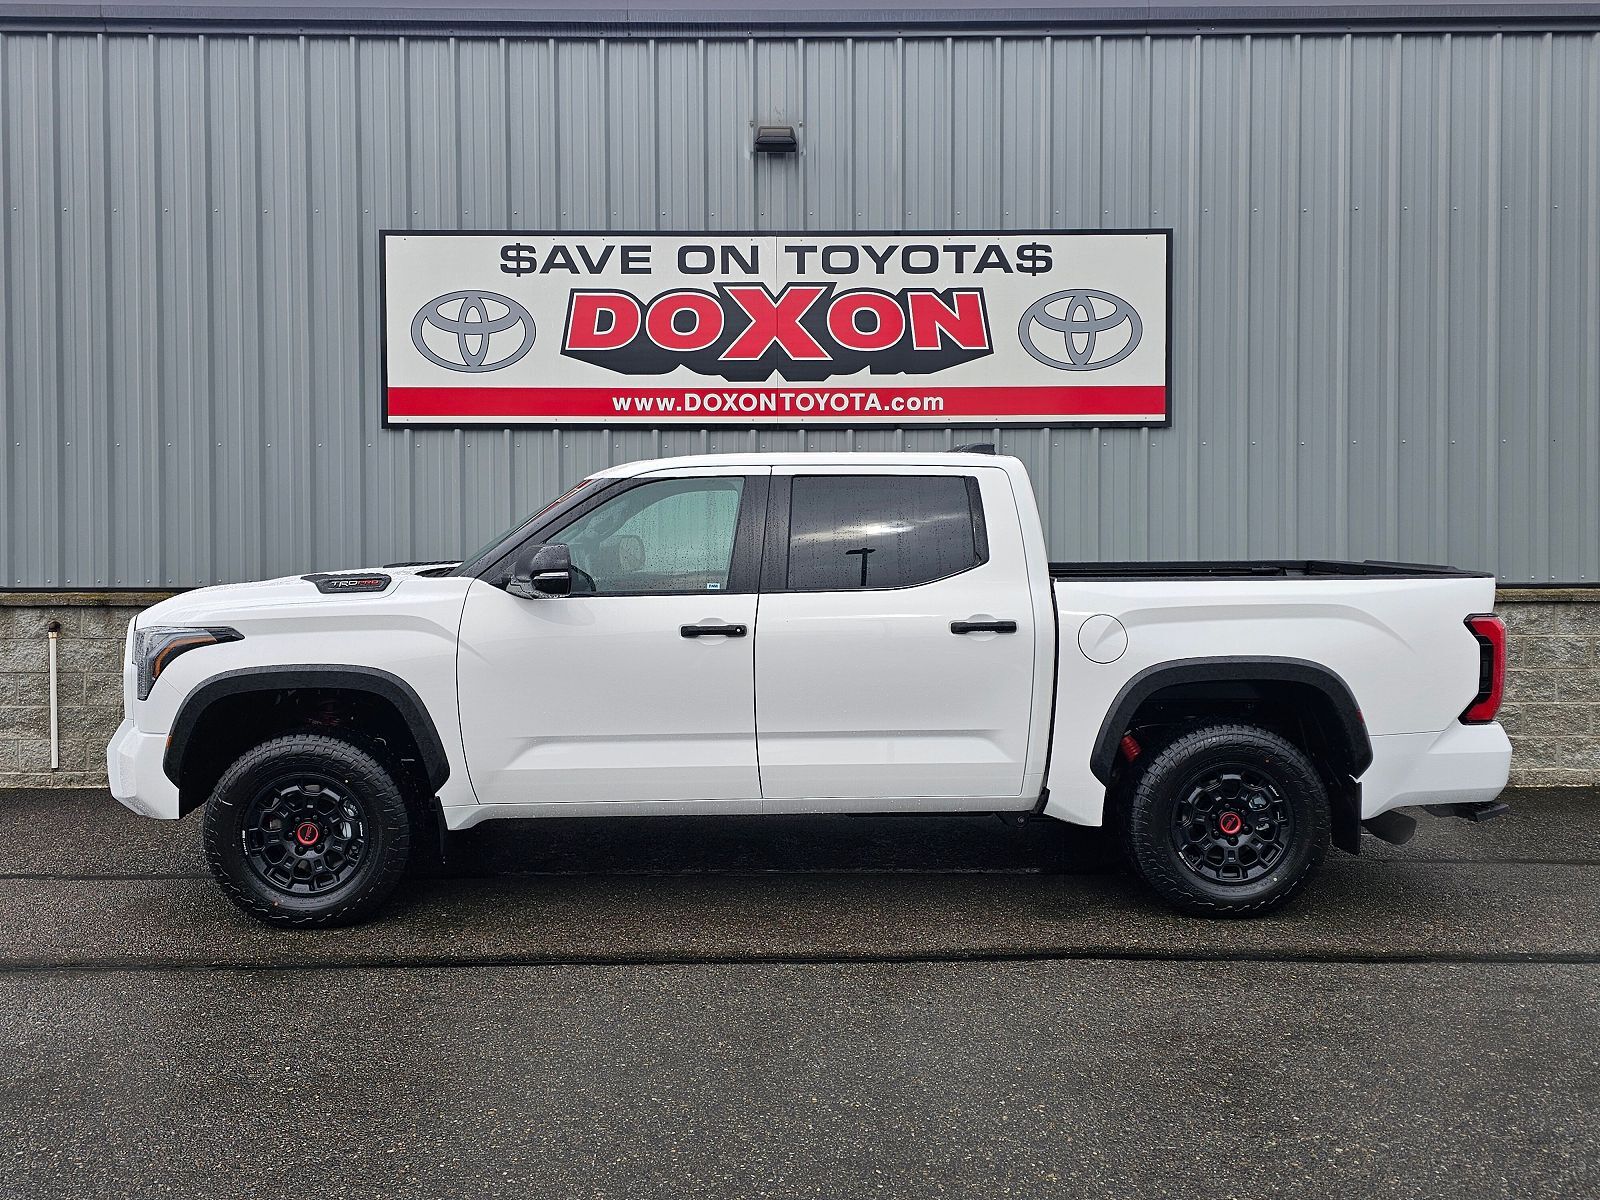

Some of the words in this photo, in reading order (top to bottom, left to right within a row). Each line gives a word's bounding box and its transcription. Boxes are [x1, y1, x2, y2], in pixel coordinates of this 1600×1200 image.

[500, 242, 652, 278] $AVE
[678, 245, 760, 275] ON
[785, 242, 1053, 277] TOYOTA$
[564, 285, 992, 364] DOXON
[612, 393, 944, 412] www.DOXONTOYOTA.com
[331, 580, 357, 588] TRD
